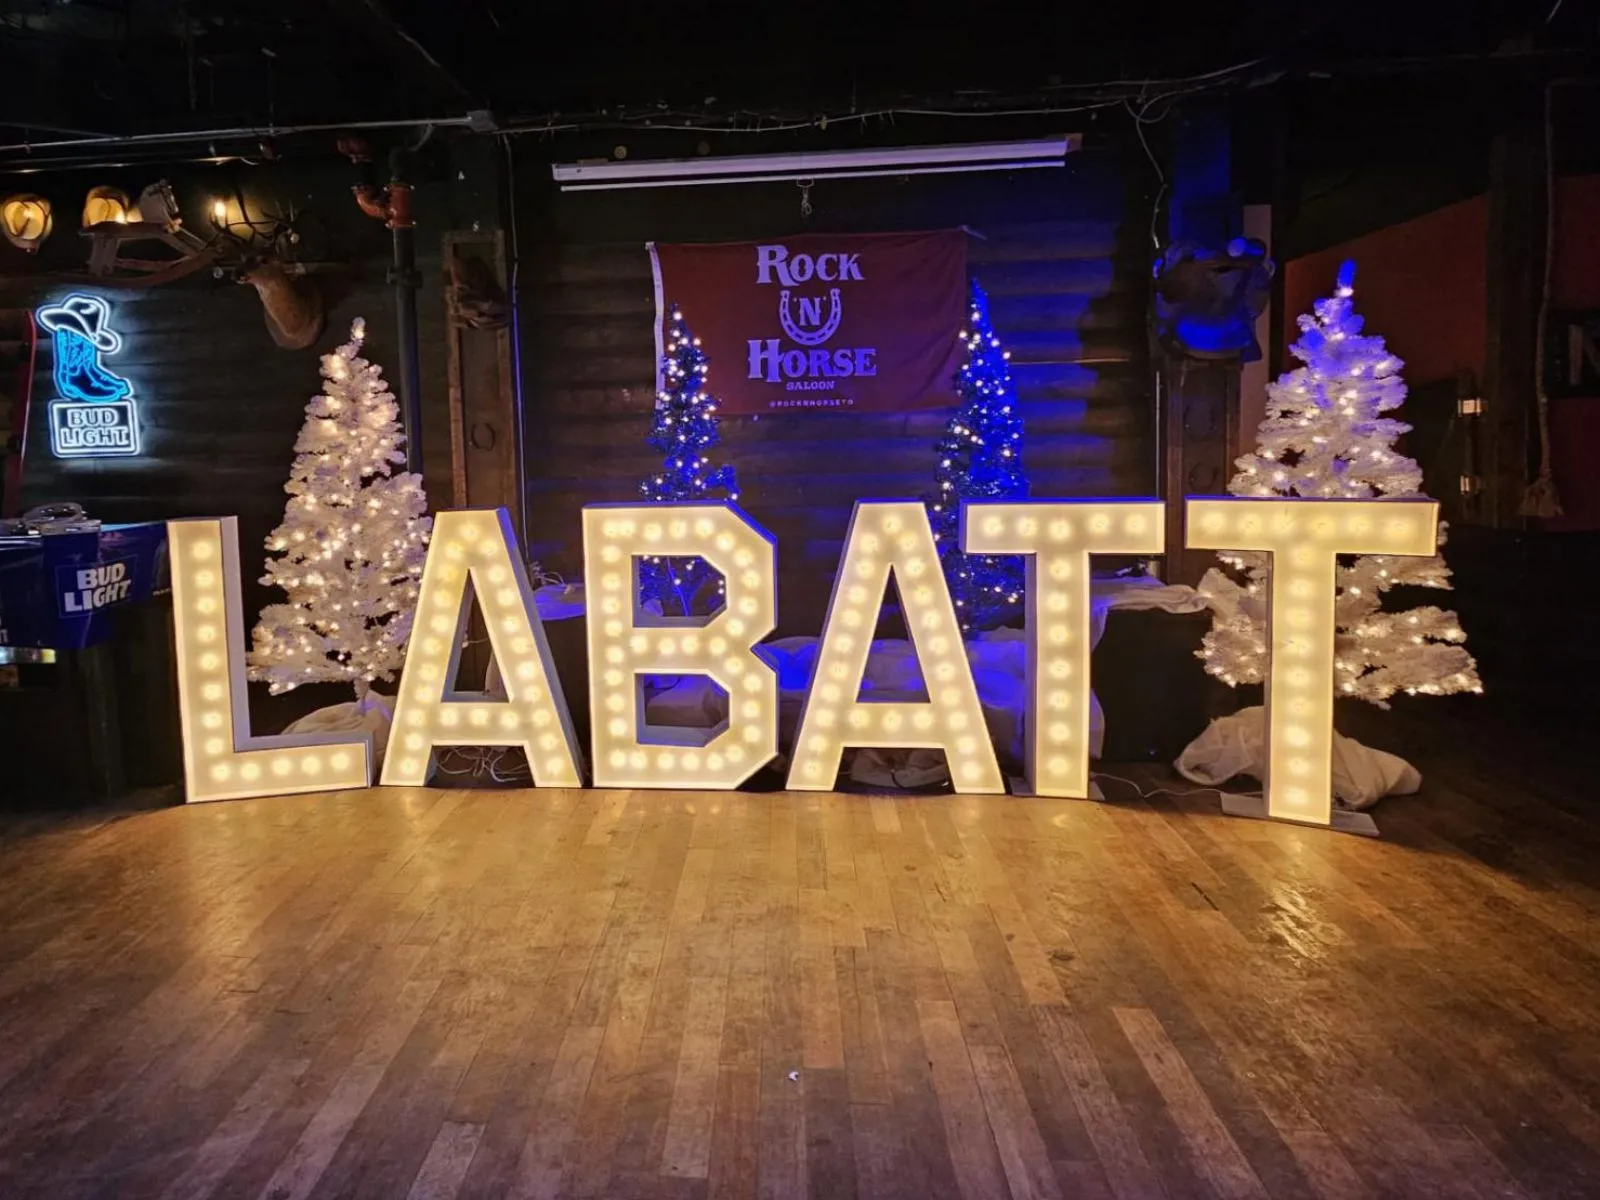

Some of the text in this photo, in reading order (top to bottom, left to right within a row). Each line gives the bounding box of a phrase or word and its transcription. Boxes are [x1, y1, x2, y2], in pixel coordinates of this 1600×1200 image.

[756, 244, 865, 287] ROCK
[747, 339, 877, 382] HORSE
[786, 380, 836, 391] SALOON
[67, 408, 119, 428] BUD
[60, 427, 130, 447] LIGHT
[76, 562, 126, 590] BUD
[64, 579, 132, 613] LIGHT
[167, 499, 1440, 826] LABATT
